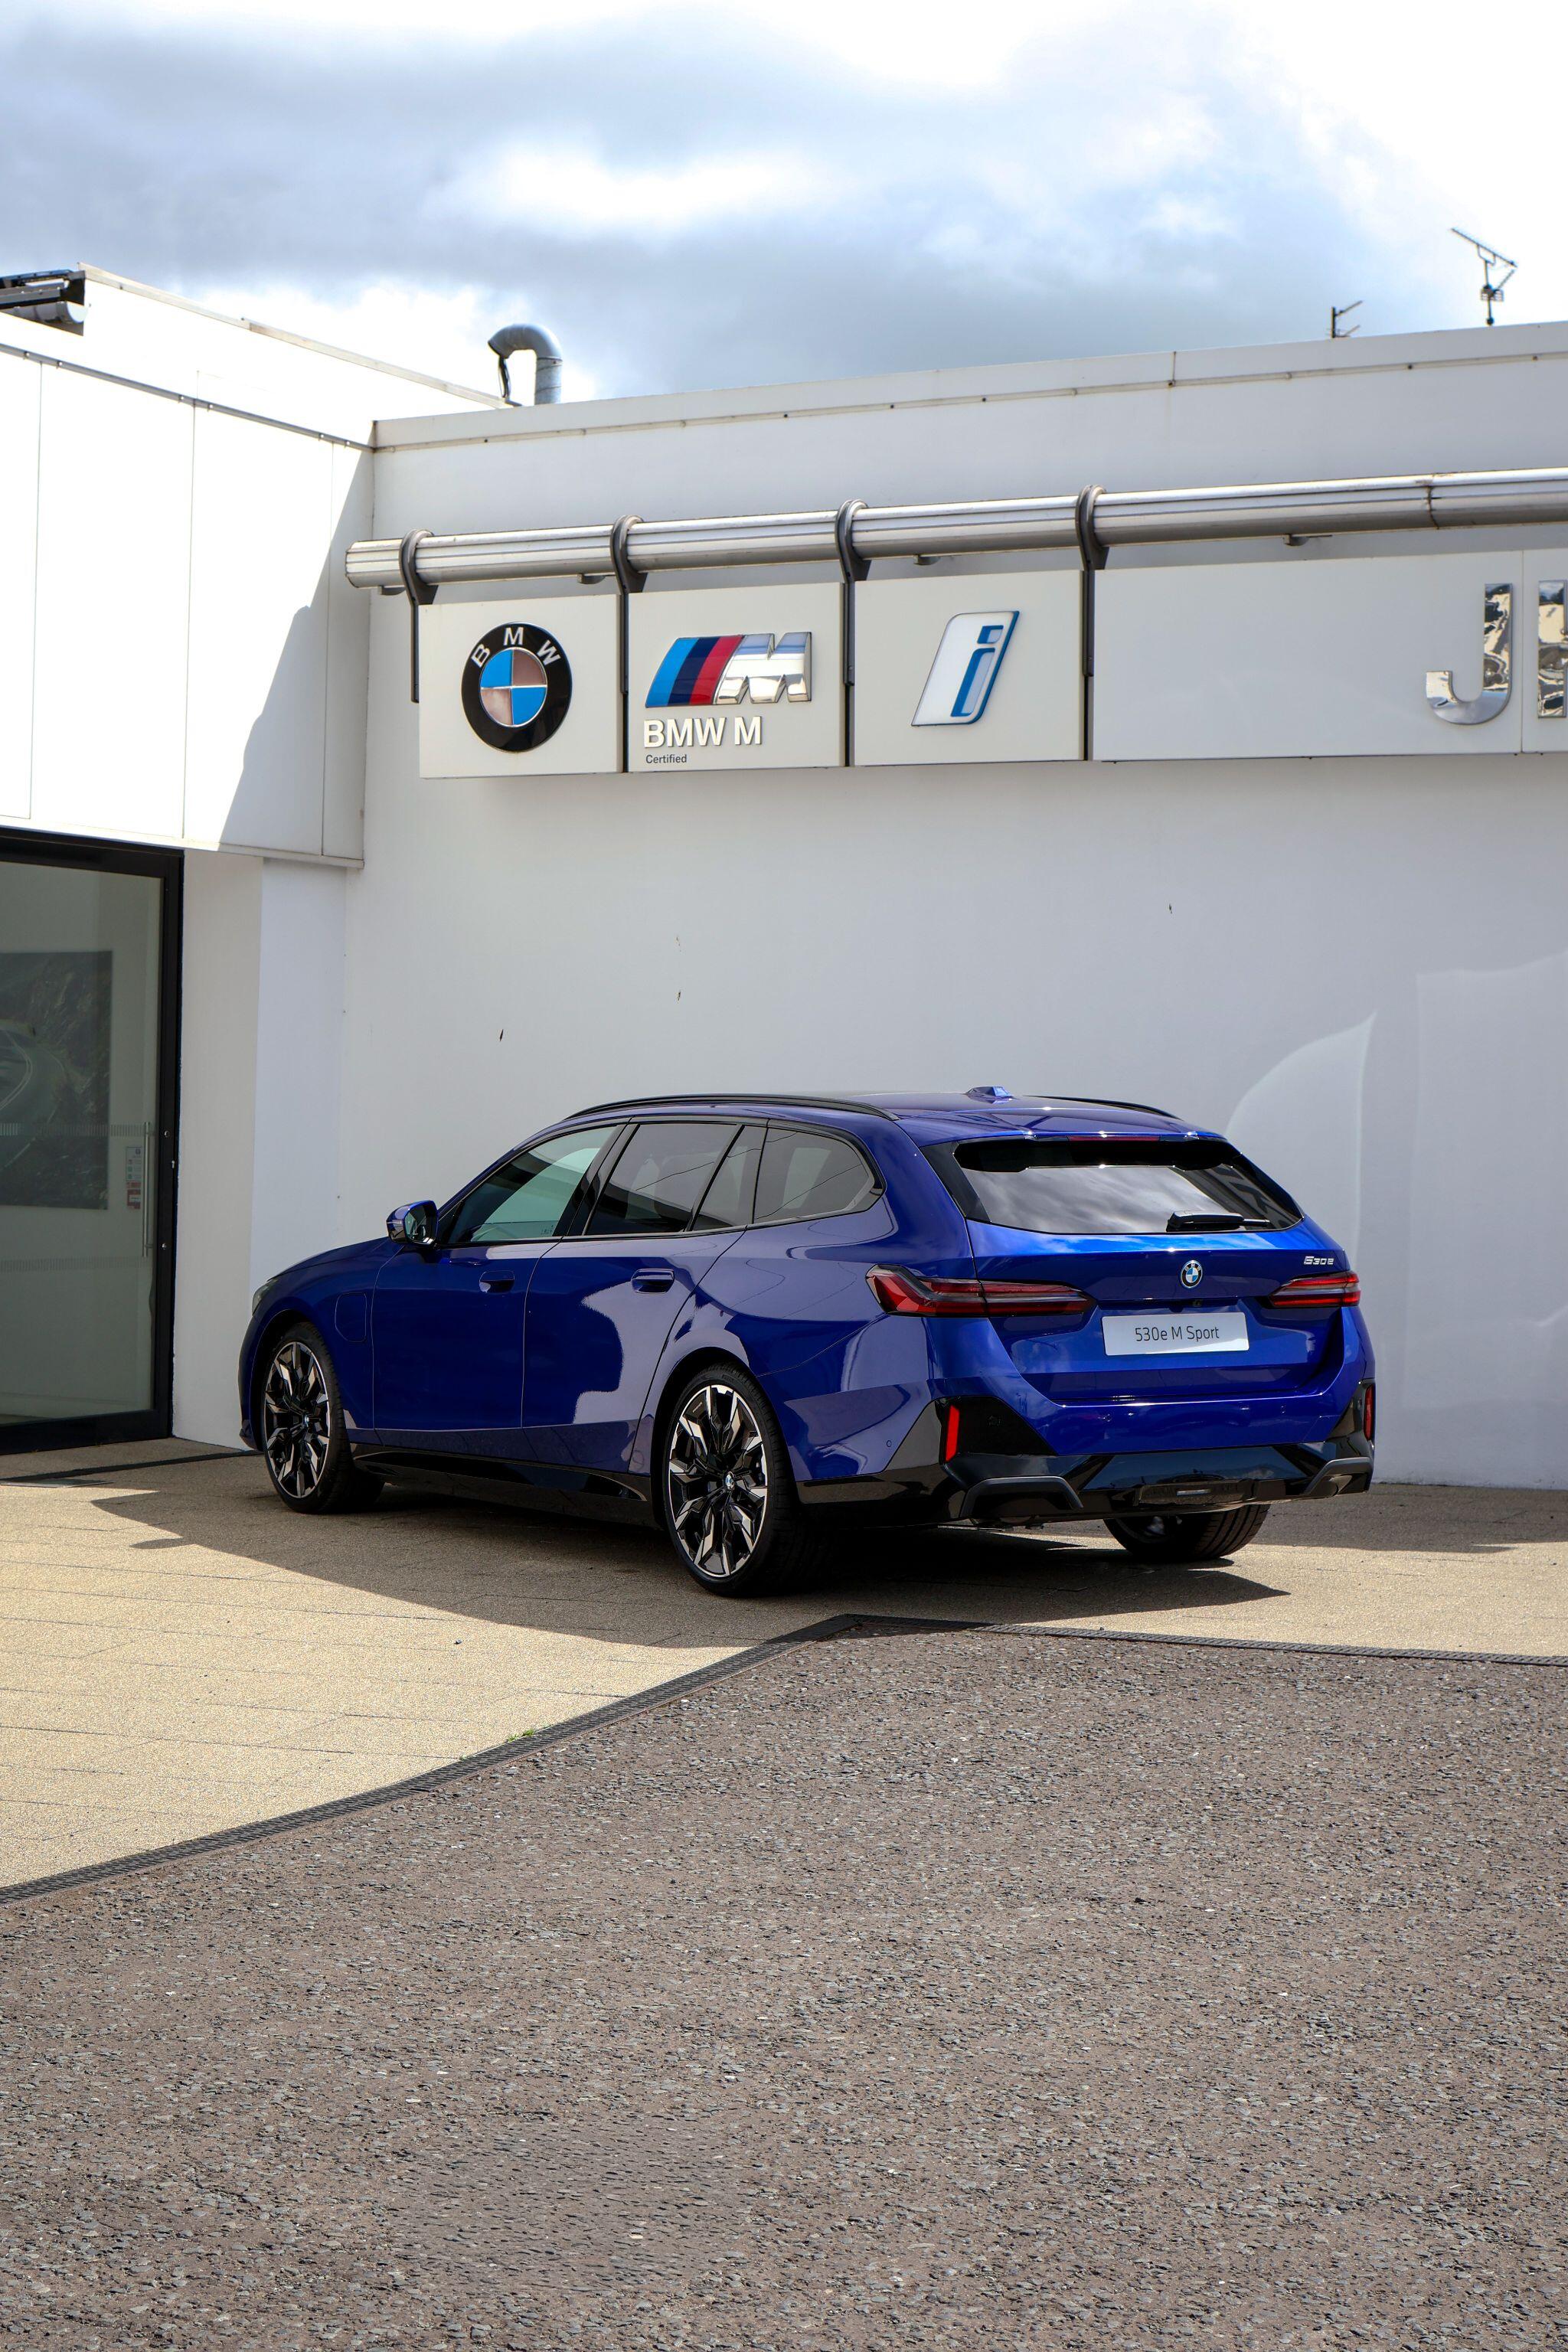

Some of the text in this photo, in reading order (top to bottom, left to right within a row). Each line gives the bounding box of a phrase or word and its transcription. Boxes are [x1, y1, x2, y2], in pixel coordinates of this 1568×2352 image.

[471, 626, 561, 668] BMW
[713, 632, 812, 705] M
[643, 716, 763, 748] BMW M
[645, 754, 688, 764] Certified
[1135, 1325, 1220, 1342] 530e M Sport
